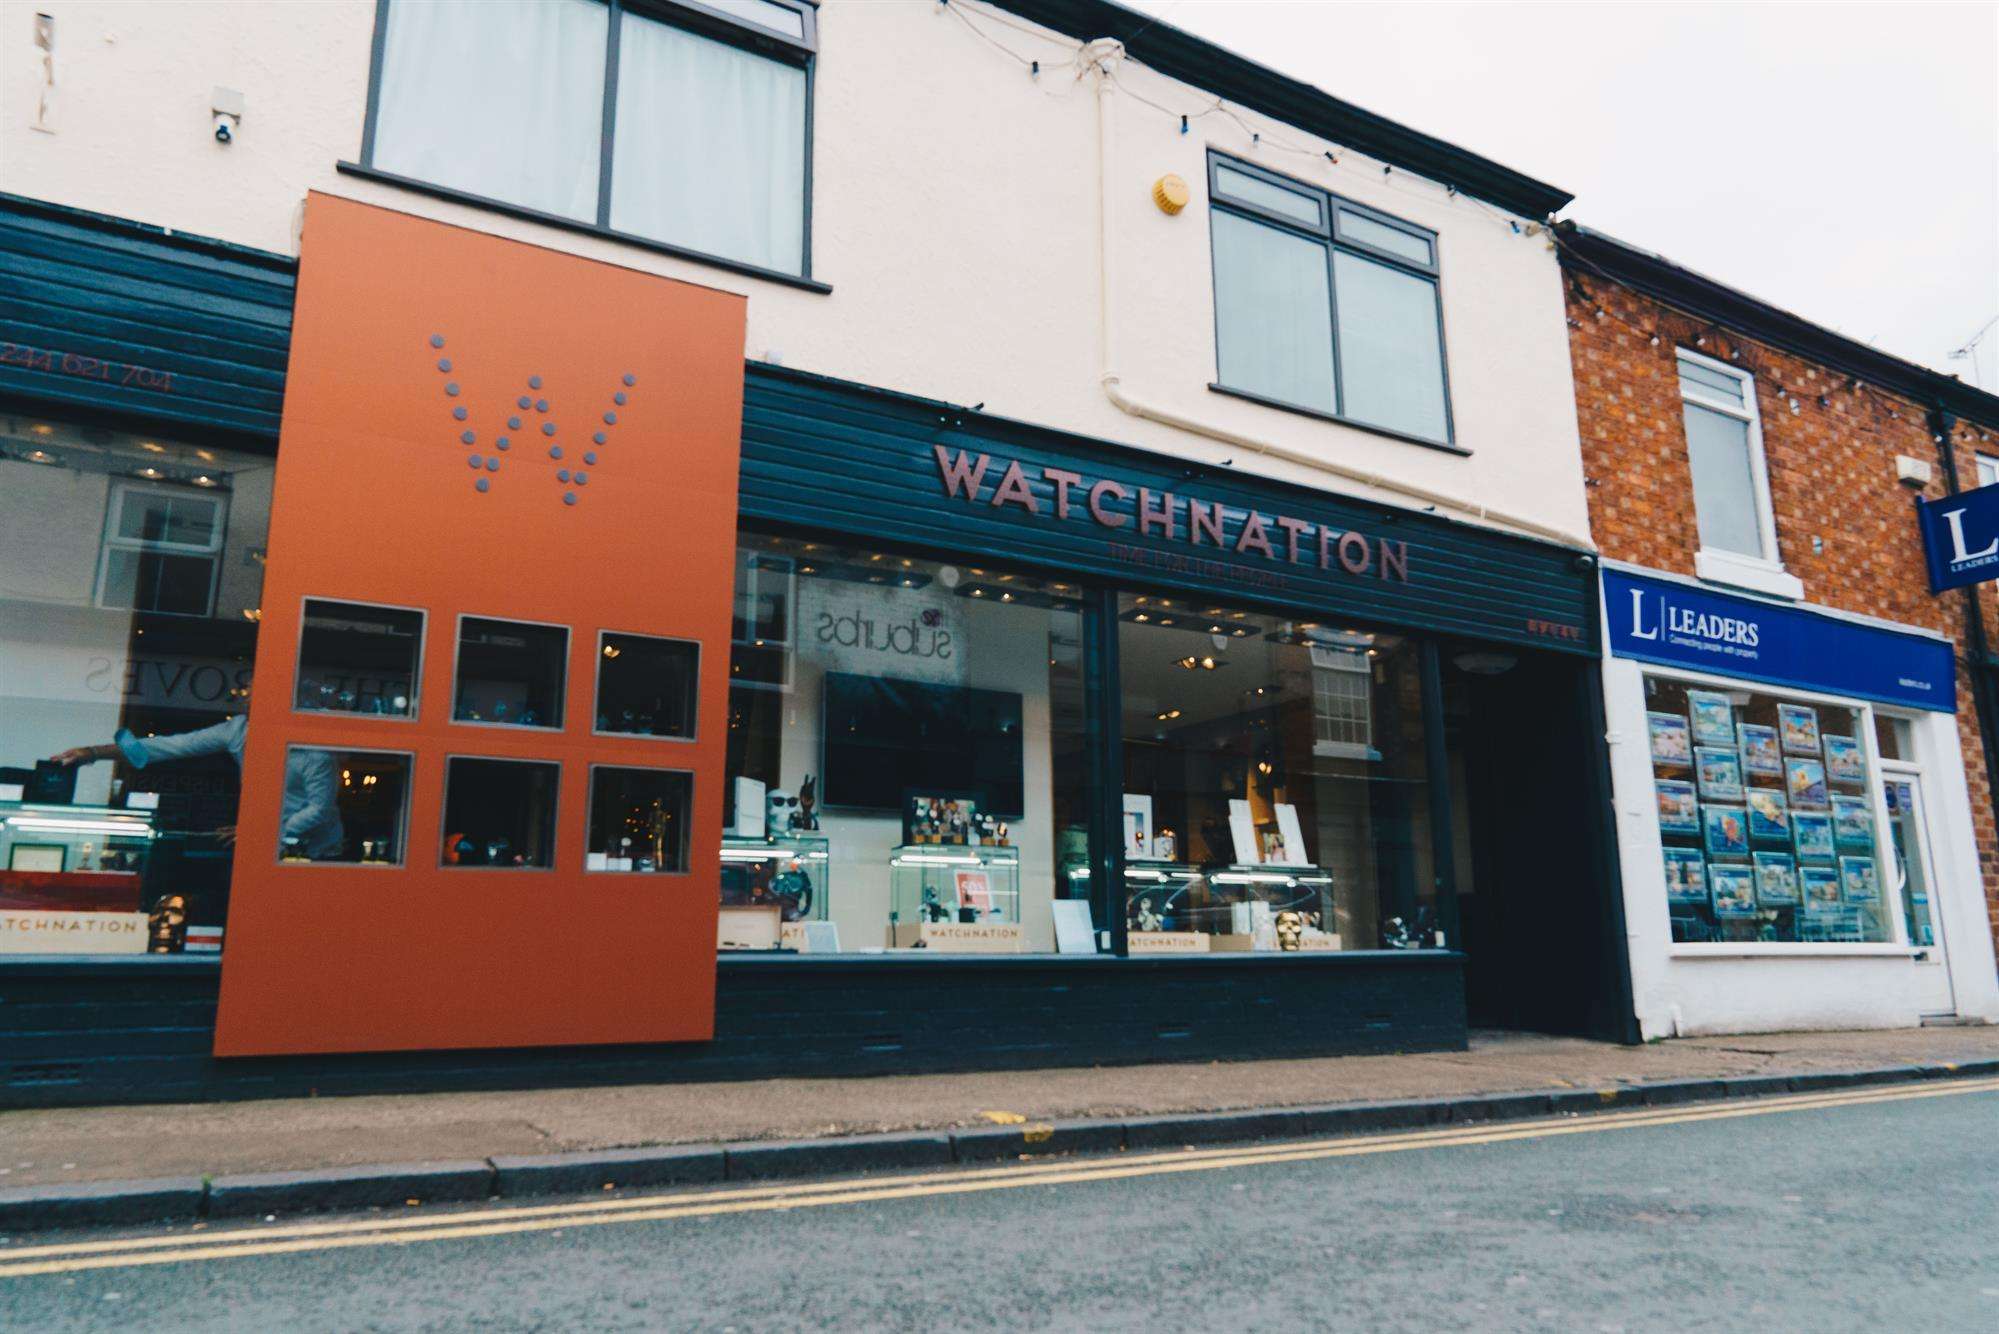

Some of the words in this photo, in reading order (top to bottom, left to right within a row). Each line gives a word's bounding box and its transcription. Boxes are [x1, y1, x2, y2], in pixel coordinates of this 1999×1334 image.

[121, 364, 175, 393] 704
[430, 335, 636, 505] W
[933, 444, 1407, 581] WATCHNATION
[1942, 508, 1999, 564] L
[1629, 588, 1658, 640] L
[1668, 606, 1759, 647] LEADERS
[0, 917, 136, 933] TCHNATION
[929, 928, 1019, 939] WATCHNATION
